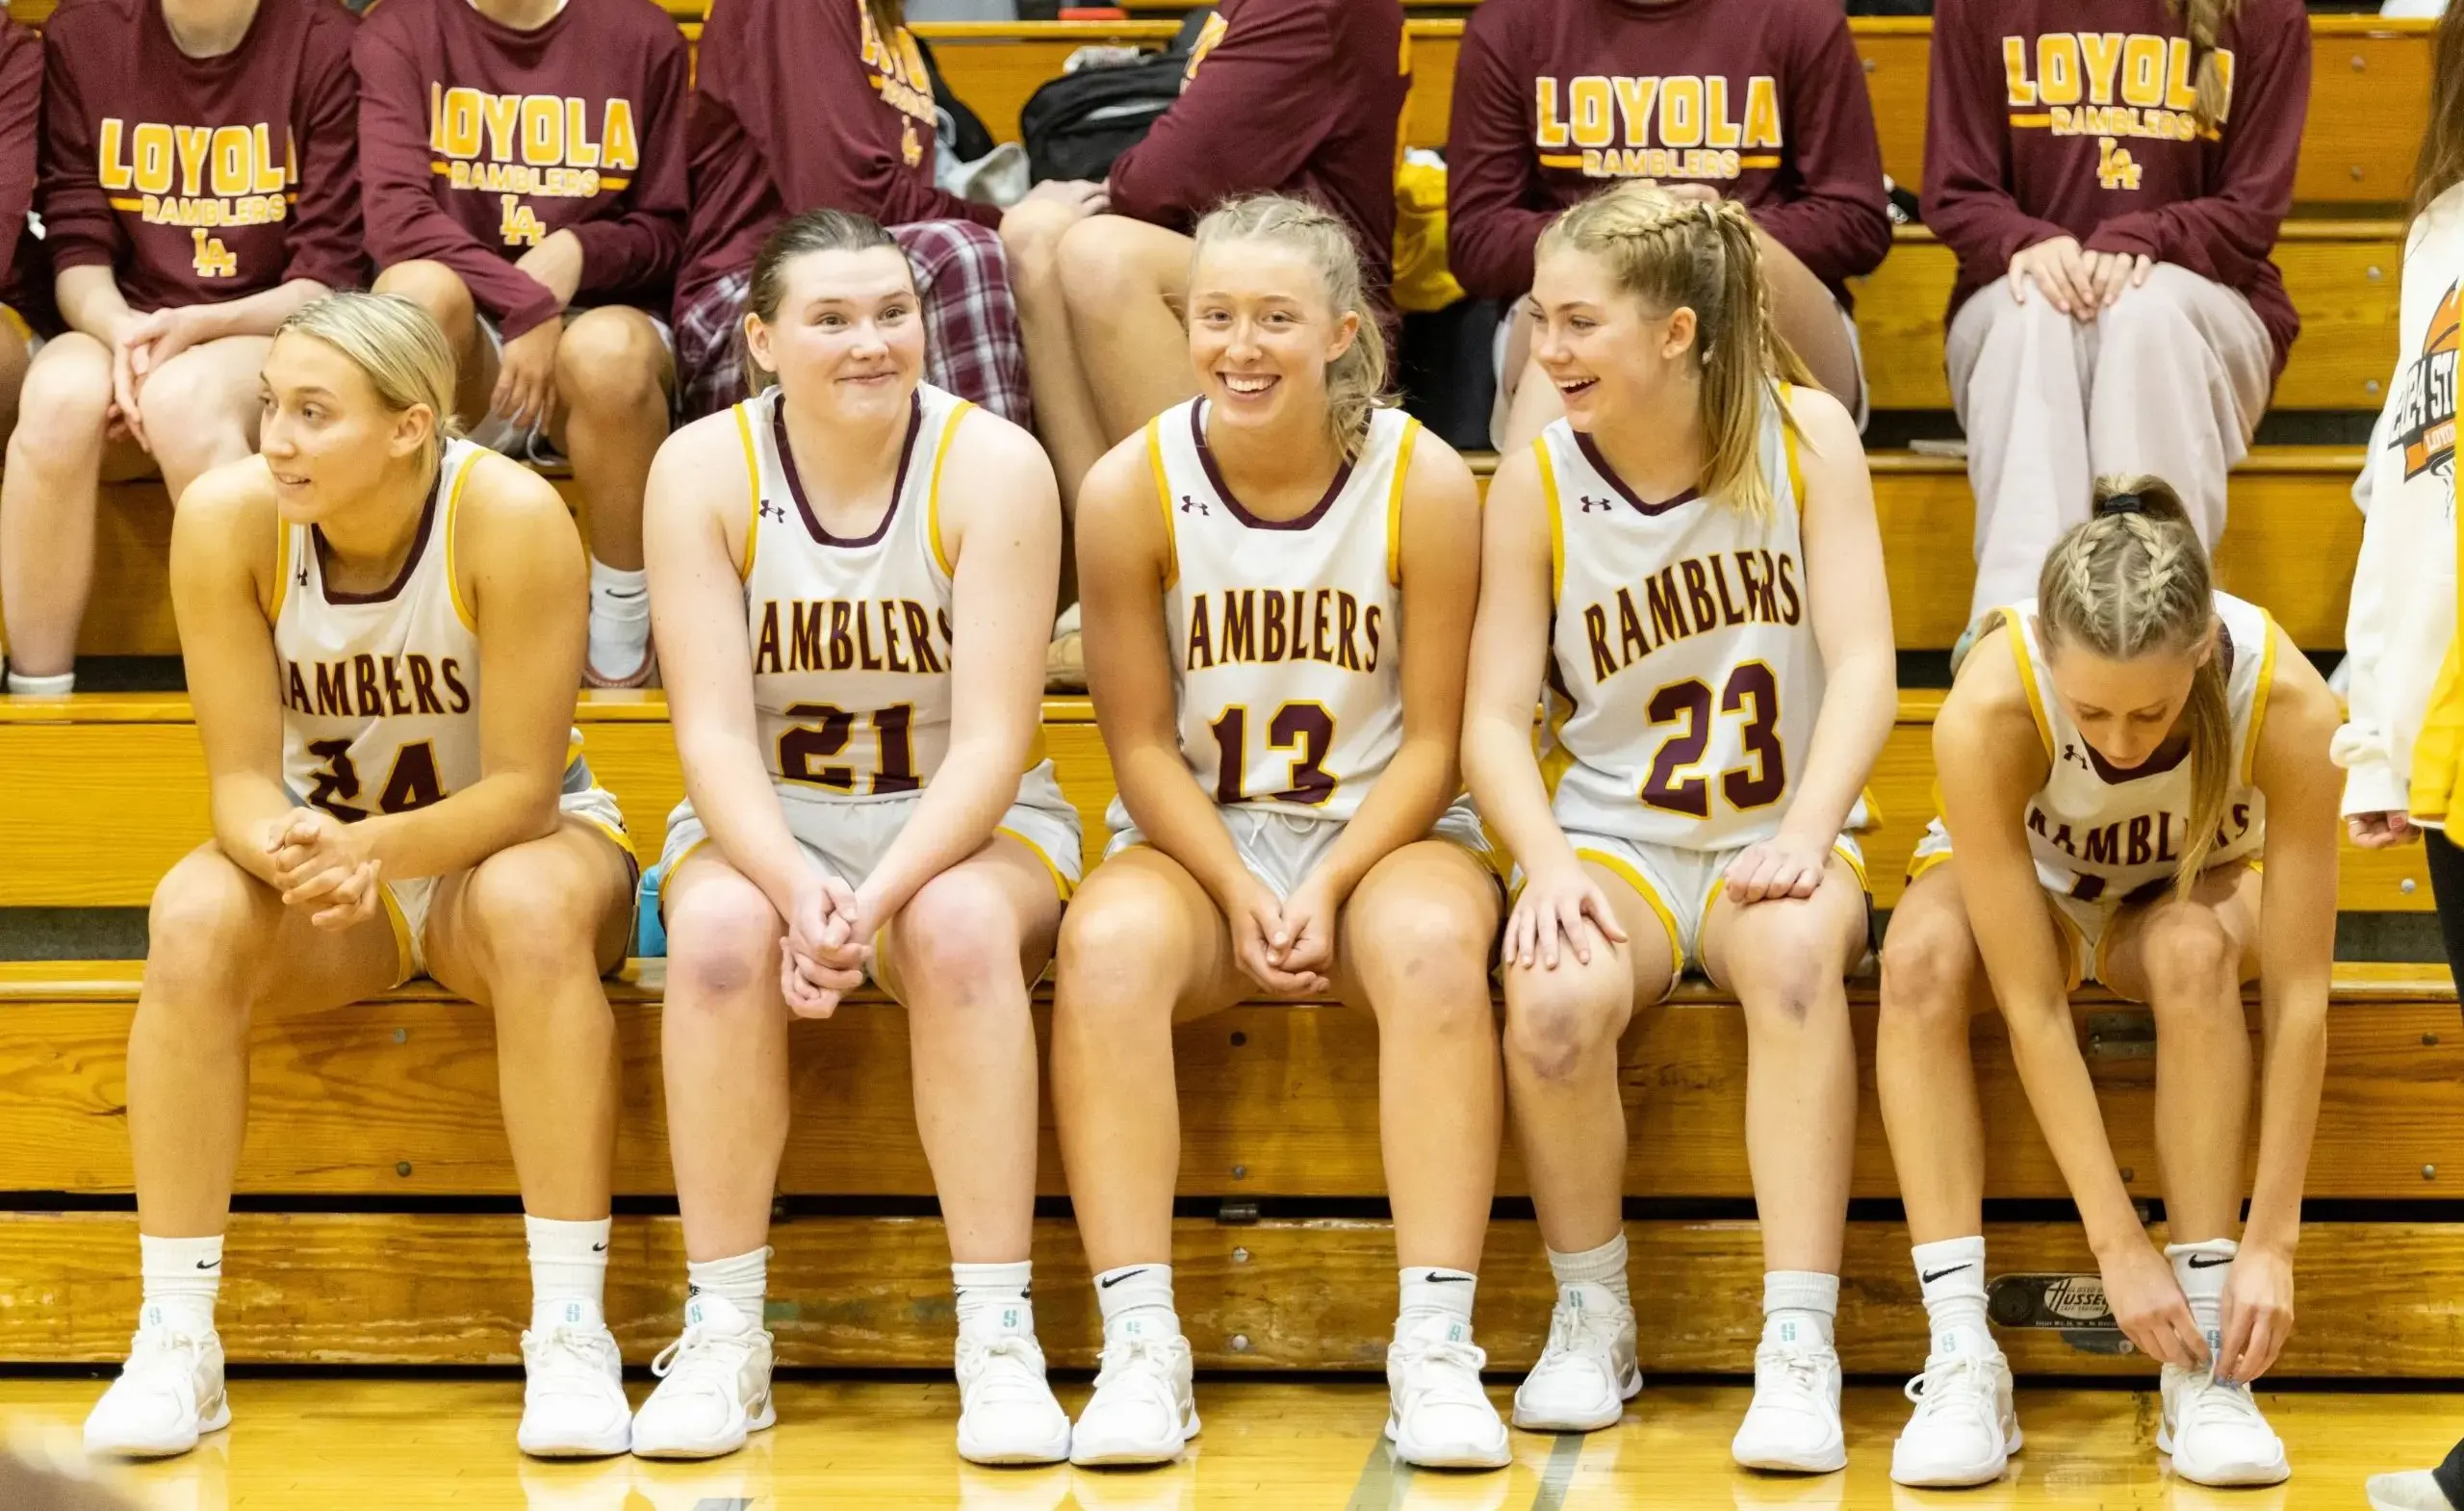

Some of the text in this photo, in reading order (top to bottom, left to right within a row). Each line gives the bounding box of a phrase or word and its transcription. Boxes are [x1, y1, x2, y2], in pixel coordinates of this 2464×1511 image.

[1535, 76, 1783, 147] LOYOLA
[2050, 106, 2196, 141] RAMBLERS
[450, 161, 601, 198] RAMBLERS
[1582, 148, 1741, 179] RAMBLERS
[2096, 137, 2143, 191] LA
[141, 193, 287, 227] RAMBLERS
[500, 193, 547, 246] LA
[192, 227, 238, 277] LA
[1187, 587, 1382, 674] AMBLERS
[1583, 549, 1802, 686] RAMBLERS
[776, 701, 925, 797] 21
[1210, 699, 1340, 808] 13
[1638, 658, 1787, 821] 23
